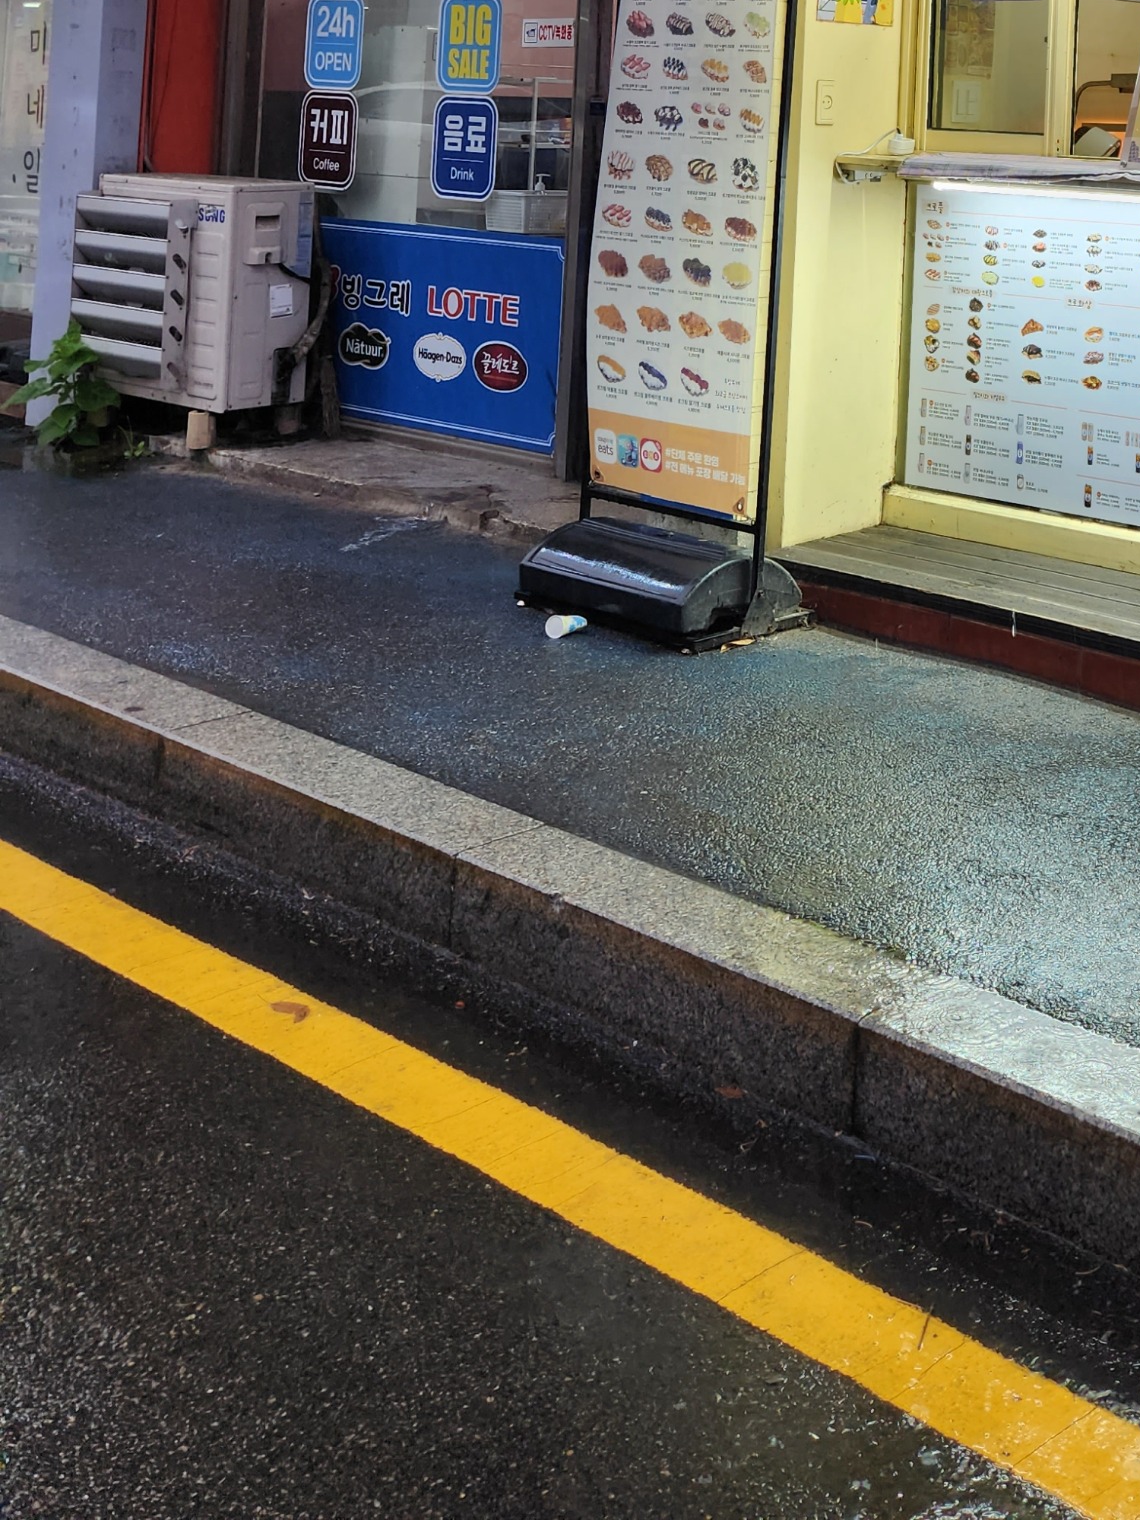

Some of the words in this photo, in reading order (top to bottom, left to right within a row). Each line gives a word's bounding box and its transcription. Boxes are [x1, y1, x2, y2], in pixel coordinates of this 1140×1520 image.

[316, 5, 355, 38] 24h
[449, 4, 493, 46] BIG
[314, 51, 352, 72] OPEN
[447, 48, 490, 80] SALE
[310, 108, 349, 145] 커피
[443, 114, 487, 154] 음료
[312, 157, 340, 172] Coffee
[450, 166, 475, 182] Drink
[341, 274, 412, 317] 빙그레
[427, 285, 520, 327] LOTTE
[598, 444, 613, 456] eats
